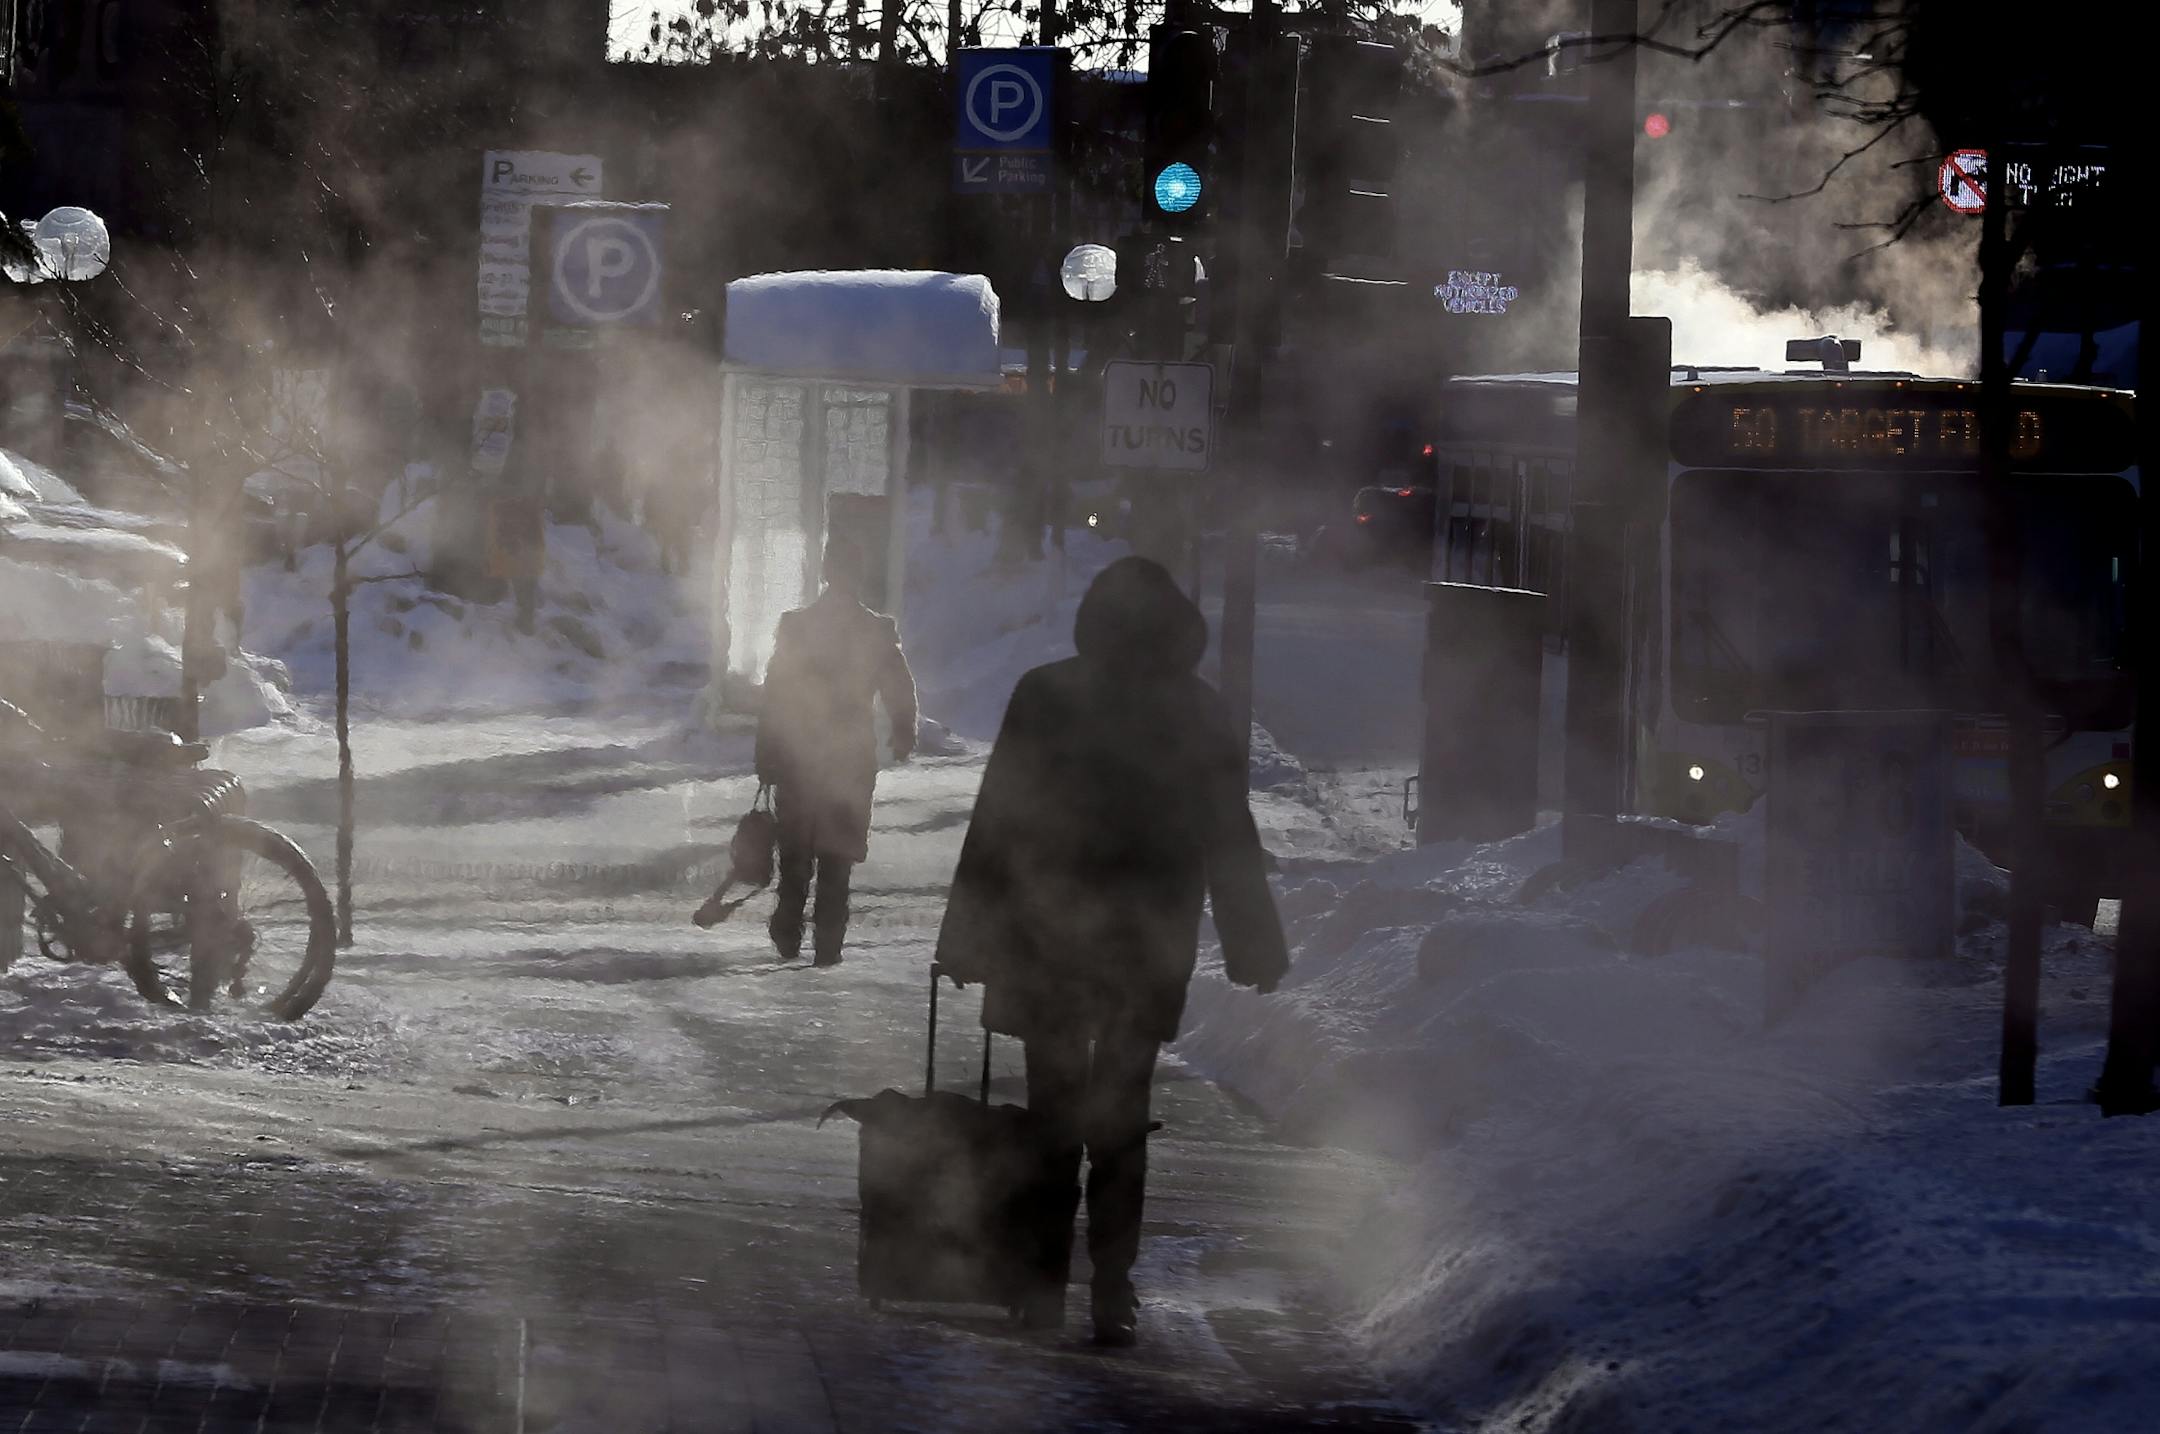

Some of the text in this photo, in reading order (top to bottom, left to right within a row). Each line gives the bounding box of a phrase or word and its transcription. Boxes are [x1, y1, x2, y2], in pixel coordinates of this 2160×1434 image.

[1000, 156, 1037, 169] Public
[998, 170, 1046, 186] Parking
[2006, 163, 2105, 187] NO IGHT
[1139, 378, 1176, 410] NO
[1732, 407, 1775, 447] 50
[1798, 407, 1926, 449] TARGET
